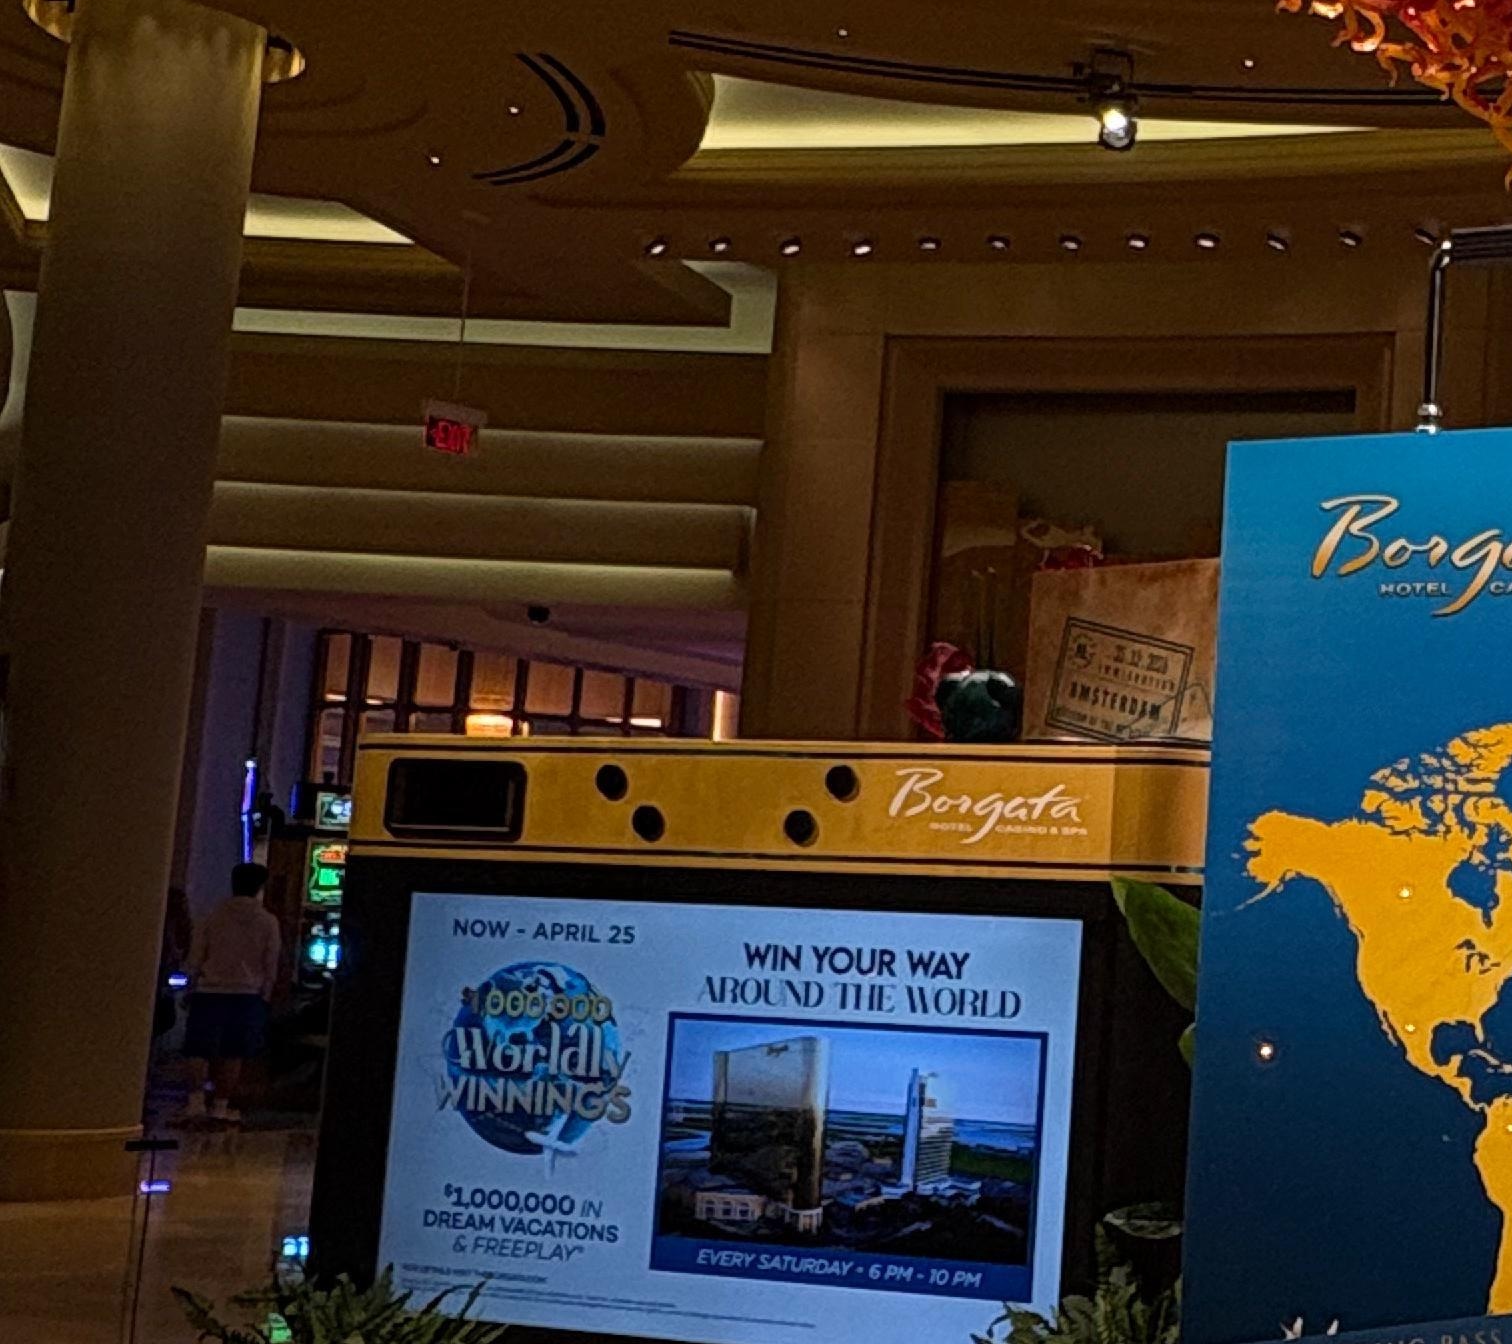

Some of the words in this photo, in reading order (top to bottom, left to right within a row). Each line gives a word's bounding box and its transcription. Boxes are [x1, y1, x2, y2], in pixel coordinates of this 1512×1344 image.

[1379, 582, 1452, 597] HOTEL
[888, 767, 1082, 844] Borgata
[453, 919, 510, 938] NOW
[533, 922, 600, 943] APRIL
[608, 925, 636, 944] 25
[743, 942, 803, 972] WIN
[811, 945, 896, 978] YOUR
[906, 949, 971, 980] WAY
[700, 976, 824, 1008] AROUND
[833, 980, 896, 1013] THE
[906, 984, 1022, 1019] WORLD
[441, 1021, 631, 1084] Worldly
[436, 1074, 631, 1124] WINNINGS
[444, 1183, 575, 1216] $1,000,000
[581, 1200, 603, 1218] IN
[423, 1209, 495, 1233] DREAM
[499, 1216, 619, 1243] VACATIONS
[452, 1235, 467, 1254] &
[696, 1249, 756, 1268] EVERY
[757, 1254, 853, 1276] SATURDAY
[868, 1264, 881, 1279] 6
[884, 1265, 914, 1282] PM
[928, 1268, 949, 1285] 10
[951, 1270, 983, 1288] PM
